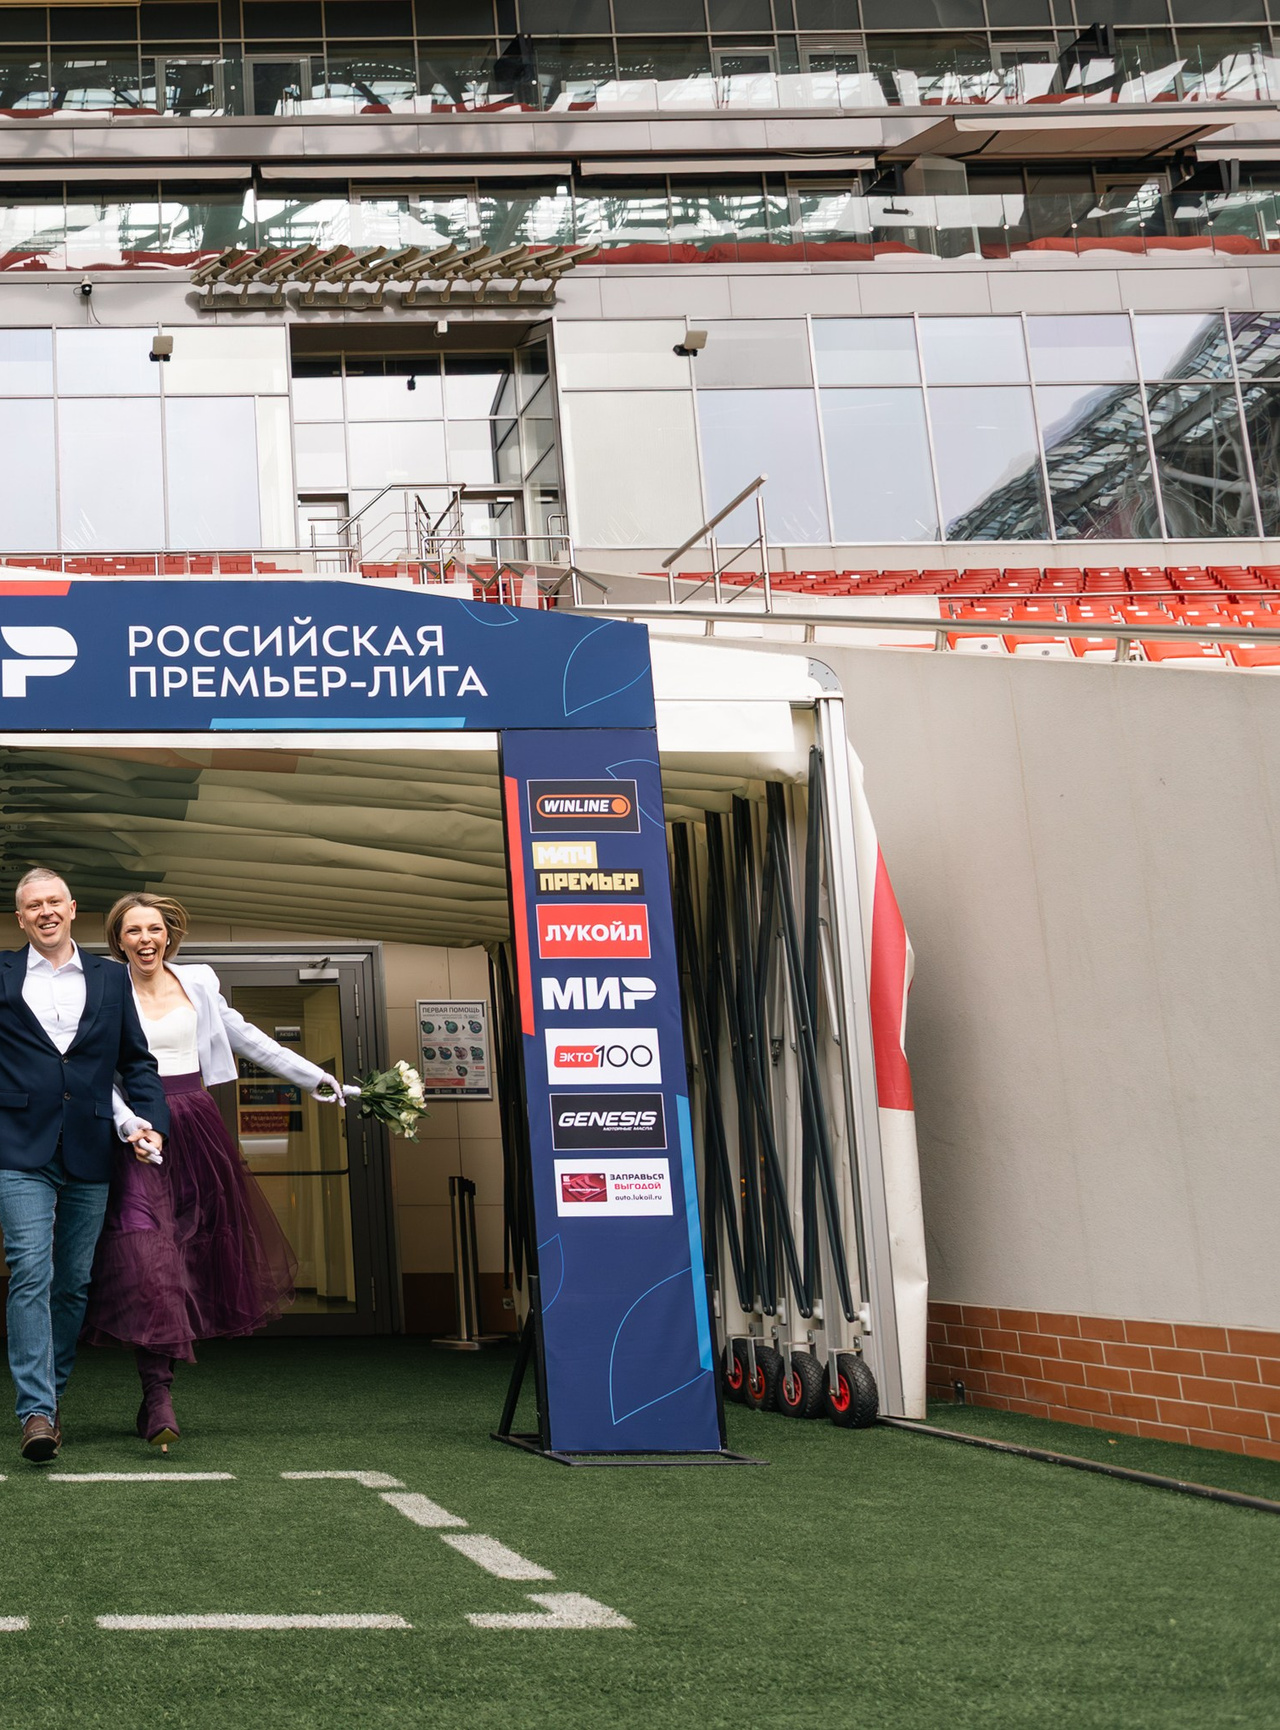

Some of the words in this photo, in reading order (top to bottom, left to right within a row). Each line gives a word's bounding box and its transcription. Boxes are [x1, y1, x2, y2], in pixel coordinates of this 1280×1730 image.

[128, 616, 445, 658] РОССИЙСКАЯ
[128, 665, 489, 698] ПРЕМЬЕР-ЛИГА
[543, 800, 610, 813] WINLINE
[536, 845, 593, 865] МАТЧ
[539, 872, 640, 891] ПРЕМЬЕР
[544, 920, 643, 942] ЛУКОЙЛ
[540, 976, 657, 1010] МИР
[557, 1111, 658, 1127] GENESIS
[614, 1181, 661, 1190] ВЫГОДОЙ
